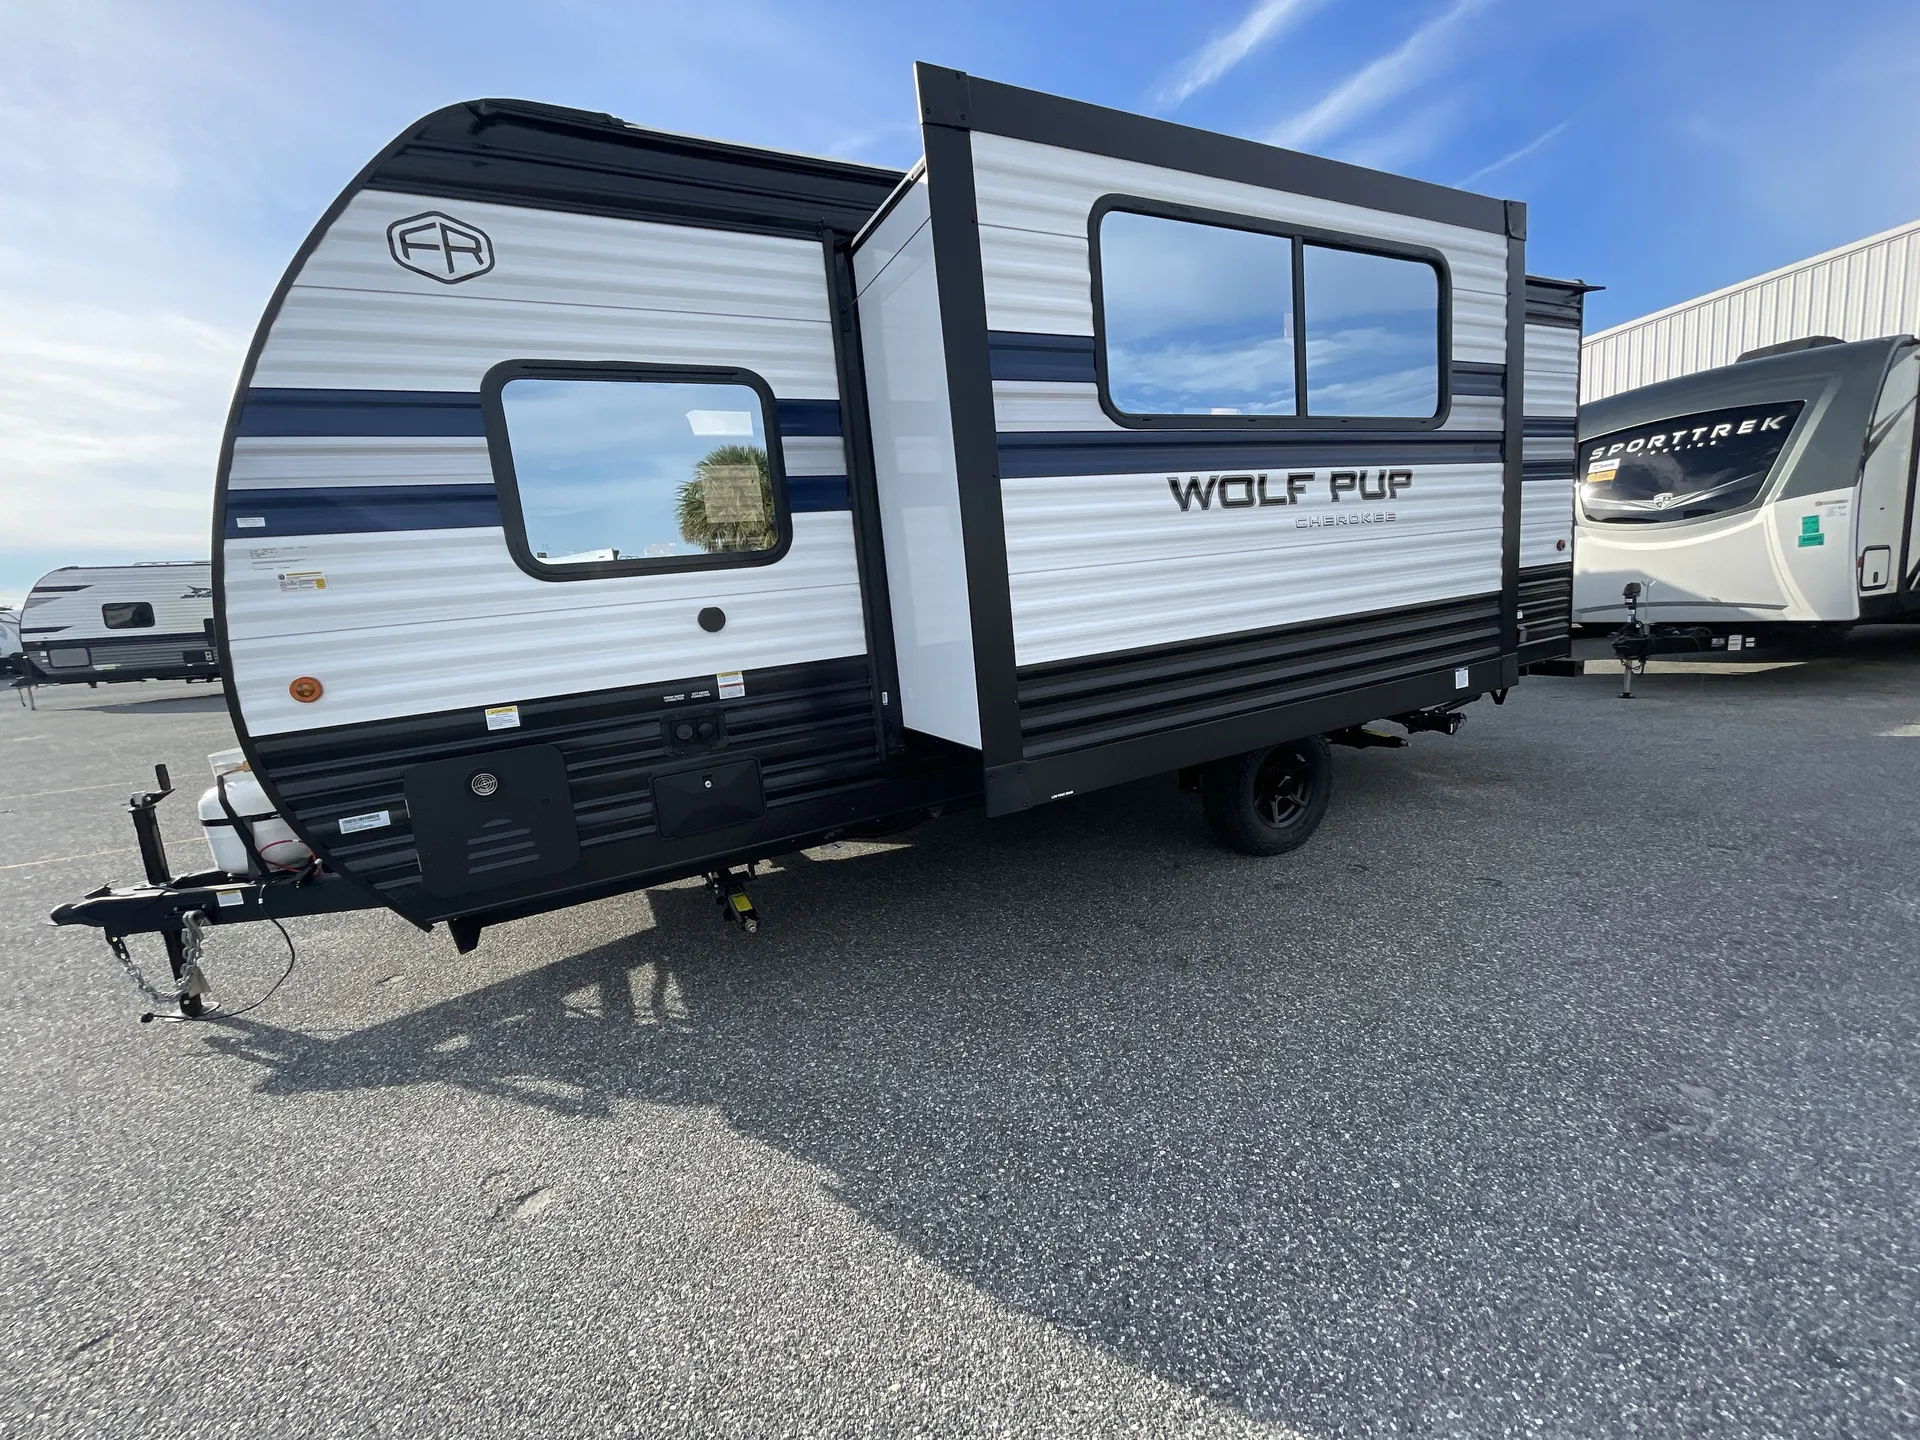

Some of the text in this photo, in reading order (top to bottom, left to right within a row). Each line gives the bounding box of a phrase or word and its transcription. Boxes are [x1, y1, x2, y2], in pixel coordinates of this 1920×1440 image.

[1588, 415, 1789, 461] SPORTTREK
[1637, 440, 1717, 457] TOURING
[1167, 468, 1413, 512] WOLF PUP
[1295, 511, 1397, 529] CHEROKEE
